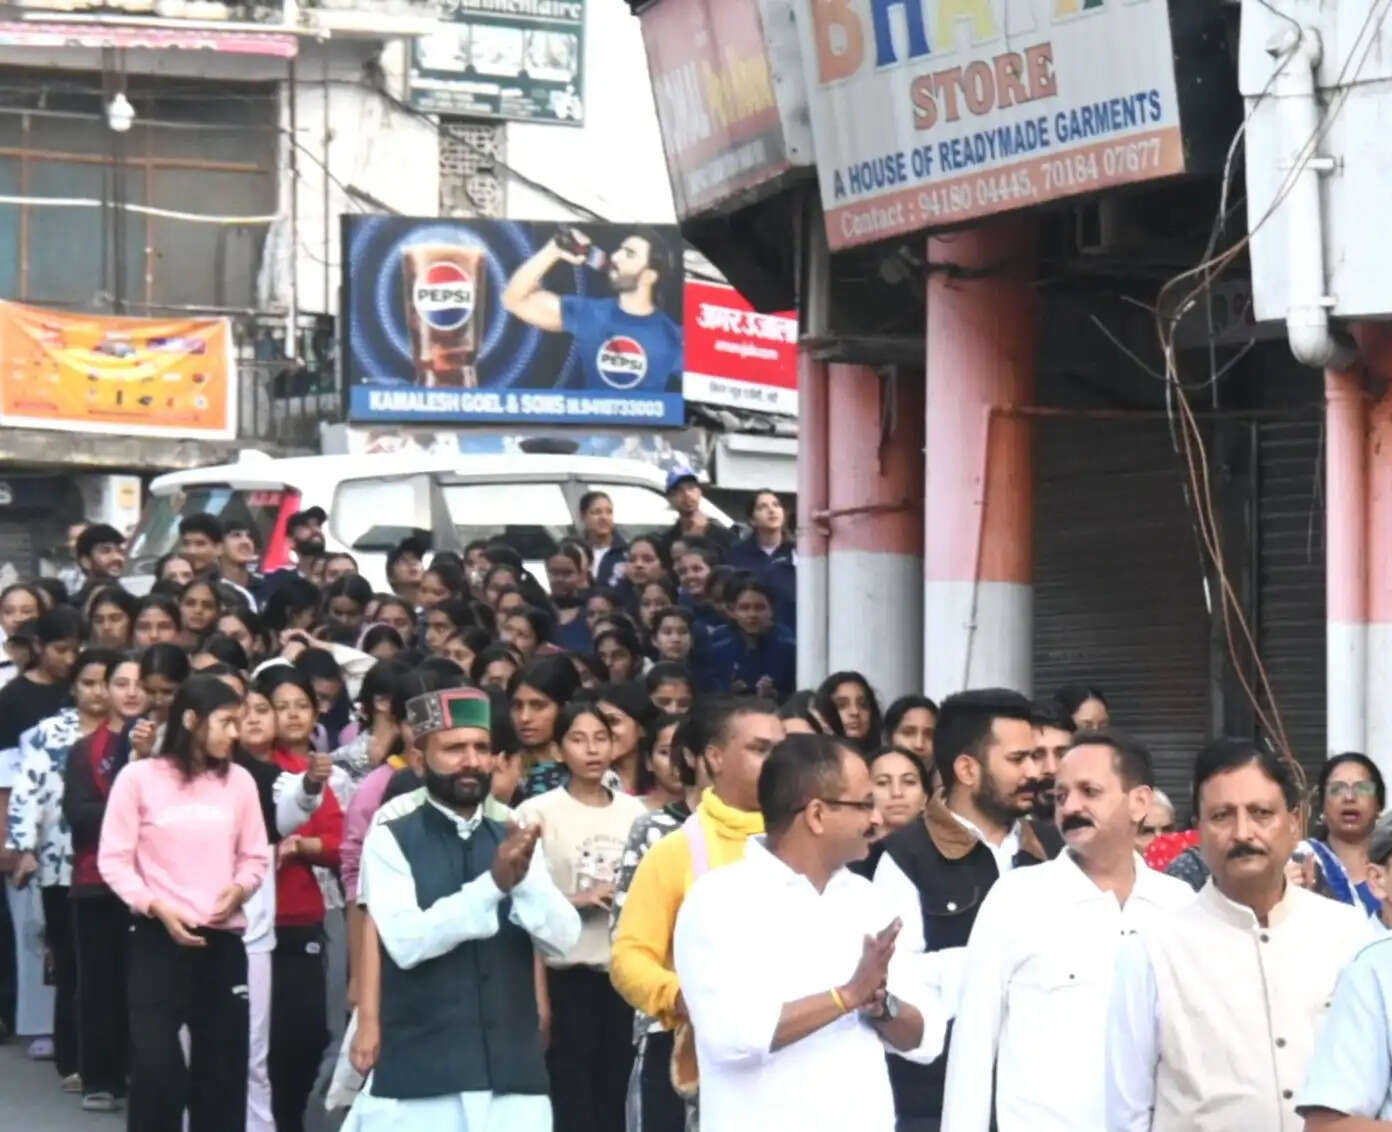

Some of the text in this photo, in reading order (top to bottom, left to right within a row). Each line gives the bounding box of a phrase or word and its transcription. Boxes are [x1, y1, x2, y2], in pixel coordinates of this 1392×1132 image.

[910, 42, 1058, 131] STORE
[833, 89, 1163, 199] A HOUSE OF READYMADE GARMENTS
[841, 203, 906, 238] Contact
[1040, 151, 1099, 192] 70184
[1103, 137, 1162, 176] 07677
[417, 288, 471, 303] PEPSI
[600, 353, 643, 371] PEPSI
[370, 391, 459, 411] KAMALESH
[461, 394, 504, 412] GOEL
[507, 395, 519, 413] &
